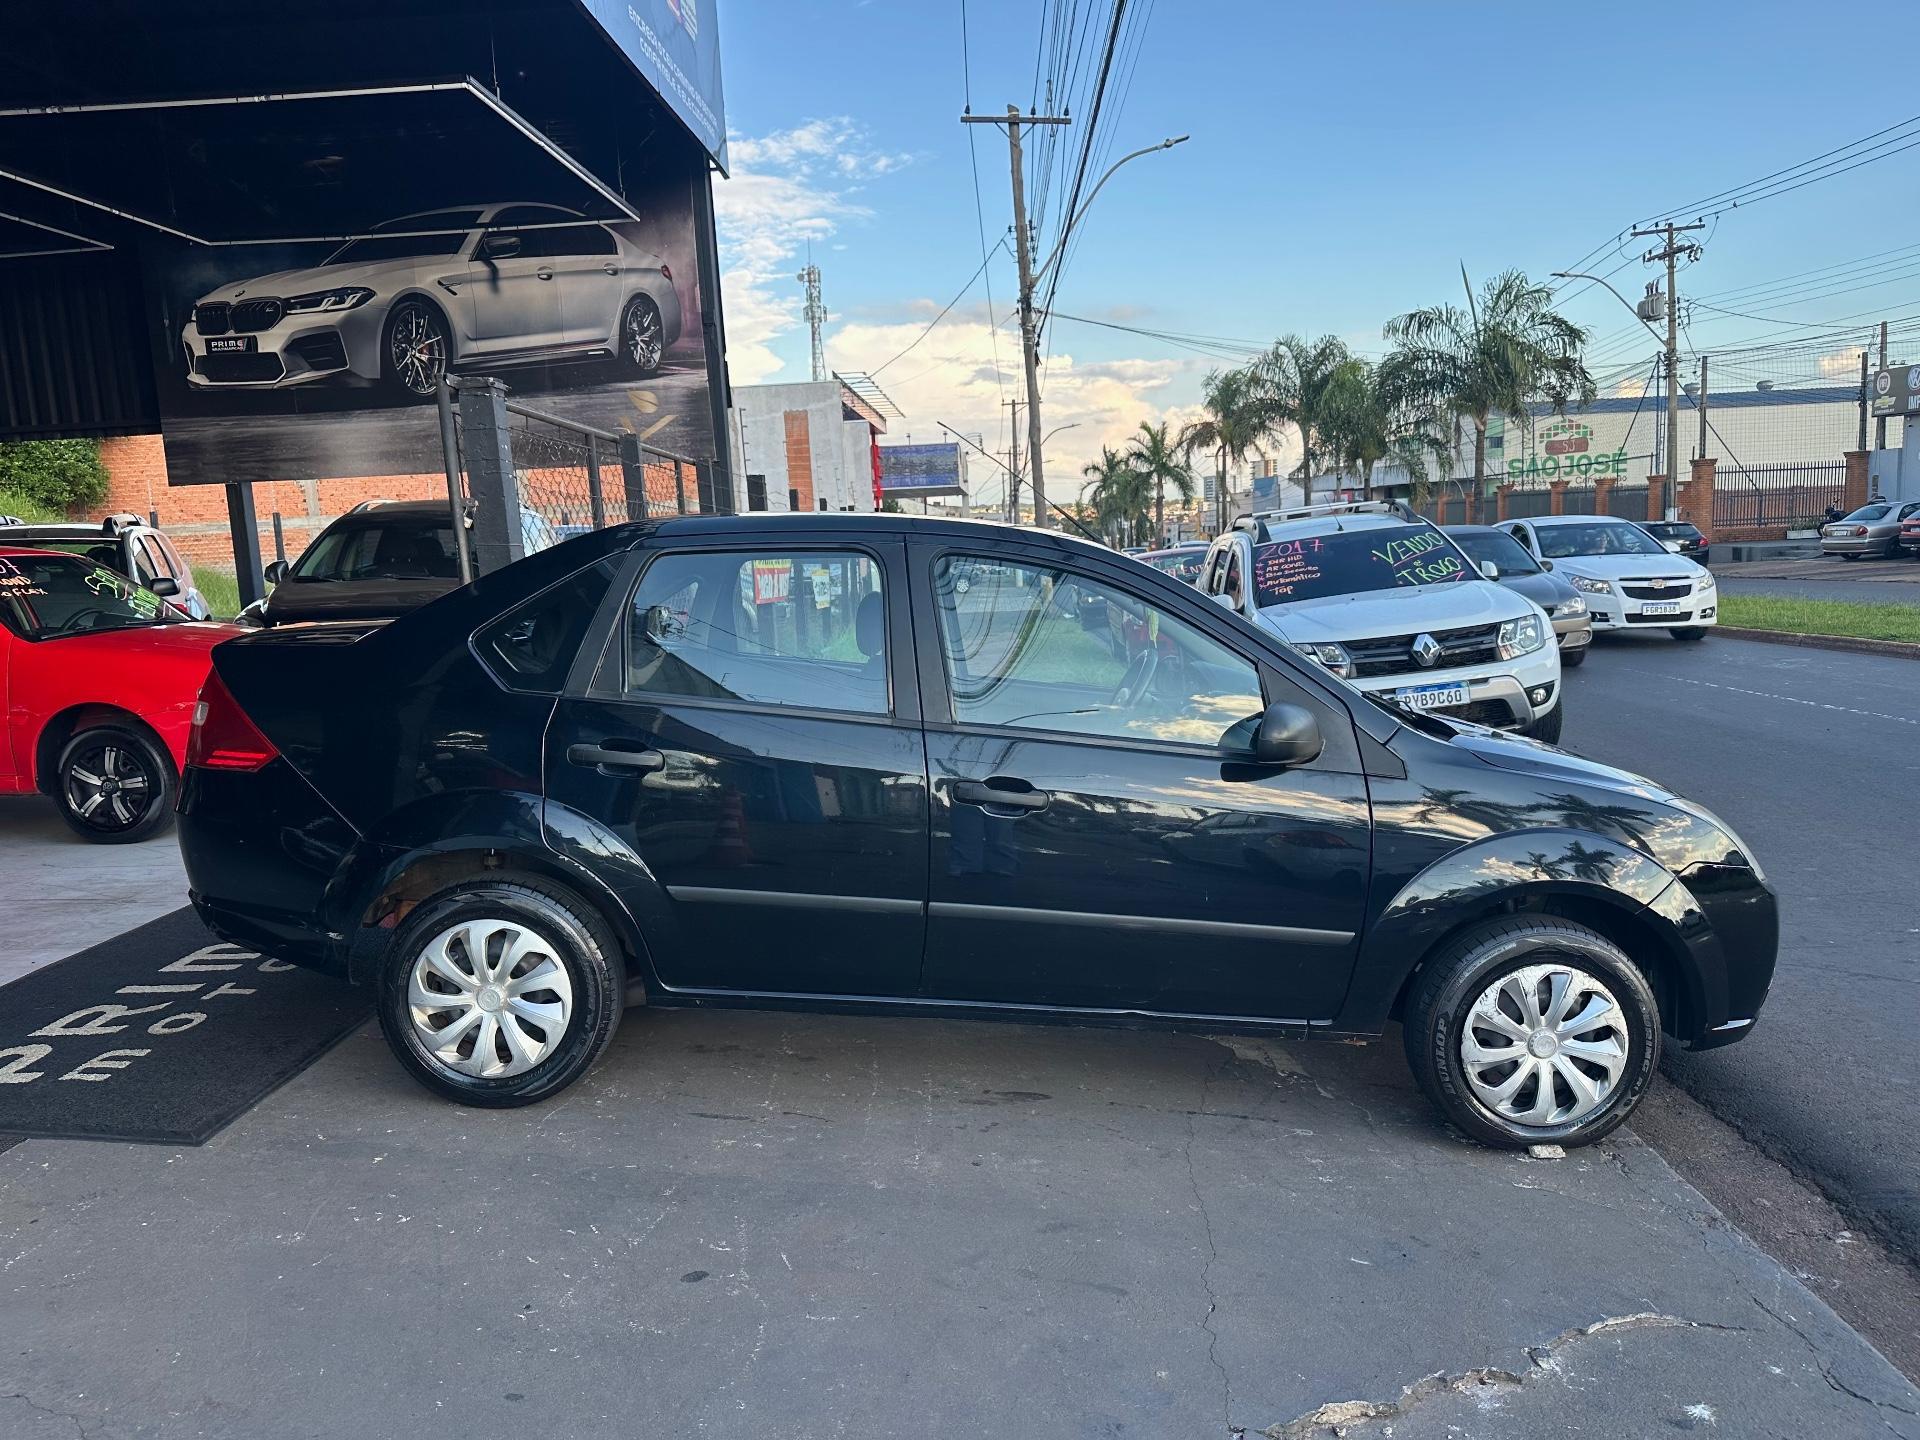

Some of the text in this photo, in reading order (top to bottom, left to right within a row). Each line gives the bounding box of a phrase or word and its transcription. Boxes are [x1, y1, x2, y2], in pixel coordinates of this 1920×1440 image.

[1507, 446, 1627, 479] SÃO JOSÉ
[1258, 539, 1324, 560] 2017
[1371, 532, 1443, 564] VENDO
[1396, 557, 1461, 585] TROCO
[12, 587, 48, 597] FLEX
[1435, 1016, 1457, 1095] DUNLOP
